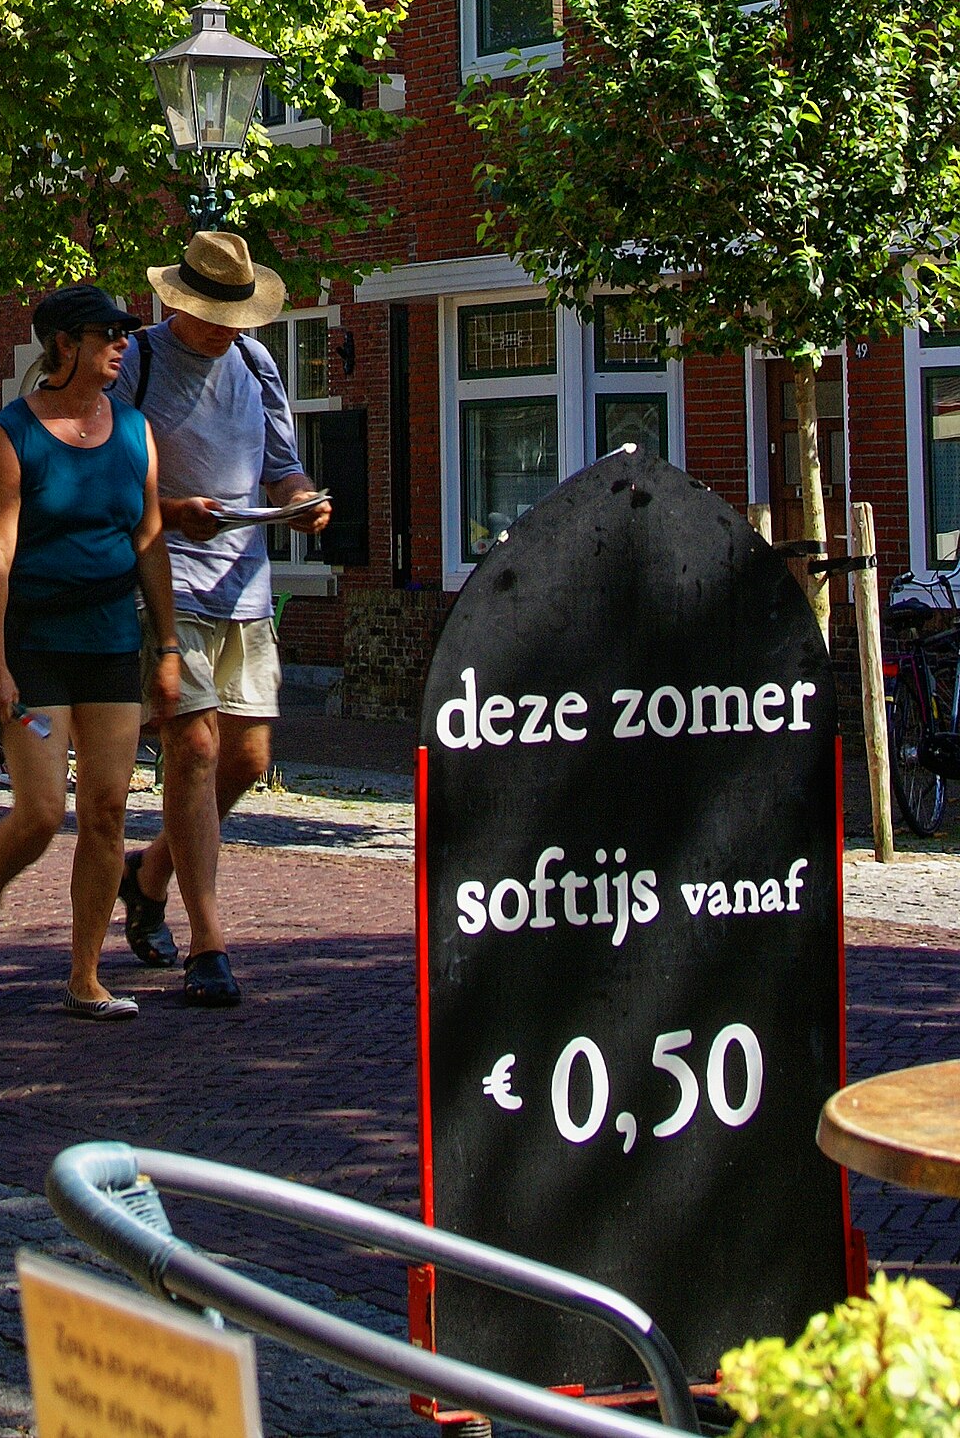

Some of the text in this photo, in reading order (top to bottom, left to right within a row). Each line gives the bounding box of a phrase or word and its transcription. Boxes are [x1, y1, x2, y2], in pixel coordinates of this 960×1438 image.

[855, 342, 868, 359] 49
[435, 666, 817, 750] deze zomer
[456, 846, 809, 947] softijs vanaf
[481, 1023, 764, 1154] € 0,50
